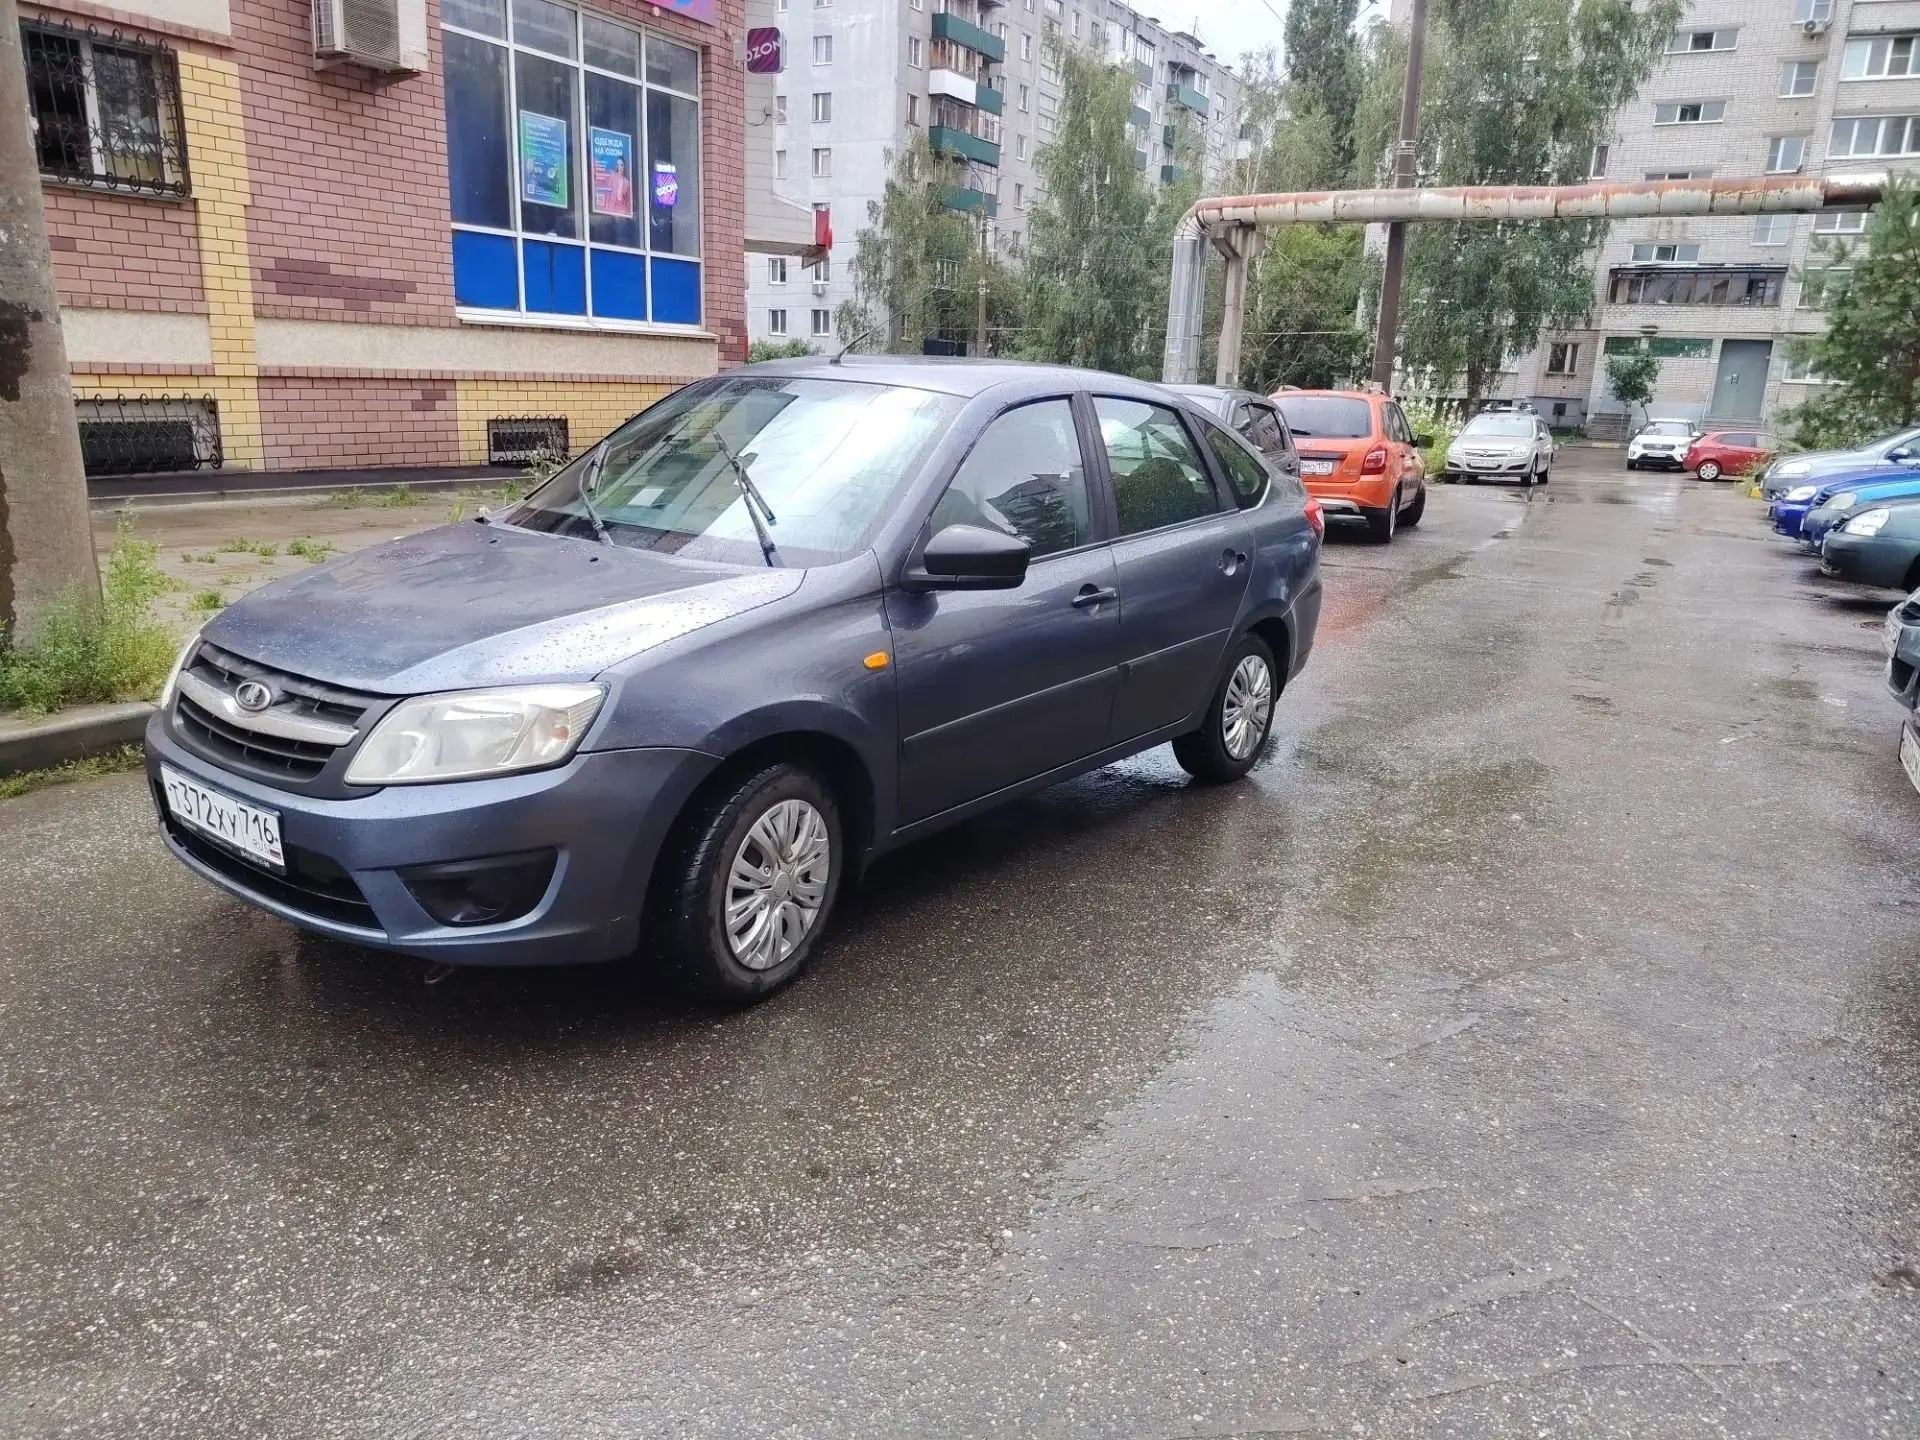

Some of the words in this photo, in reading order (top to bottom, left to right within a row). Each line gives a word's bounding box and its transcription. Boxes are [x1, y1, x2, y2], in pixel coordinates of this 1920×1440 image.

[594, 136, 623, 149] ОДЕЖДА
[595, 146, 605, 155] НА
[605, 147, 623, 157] OZON
